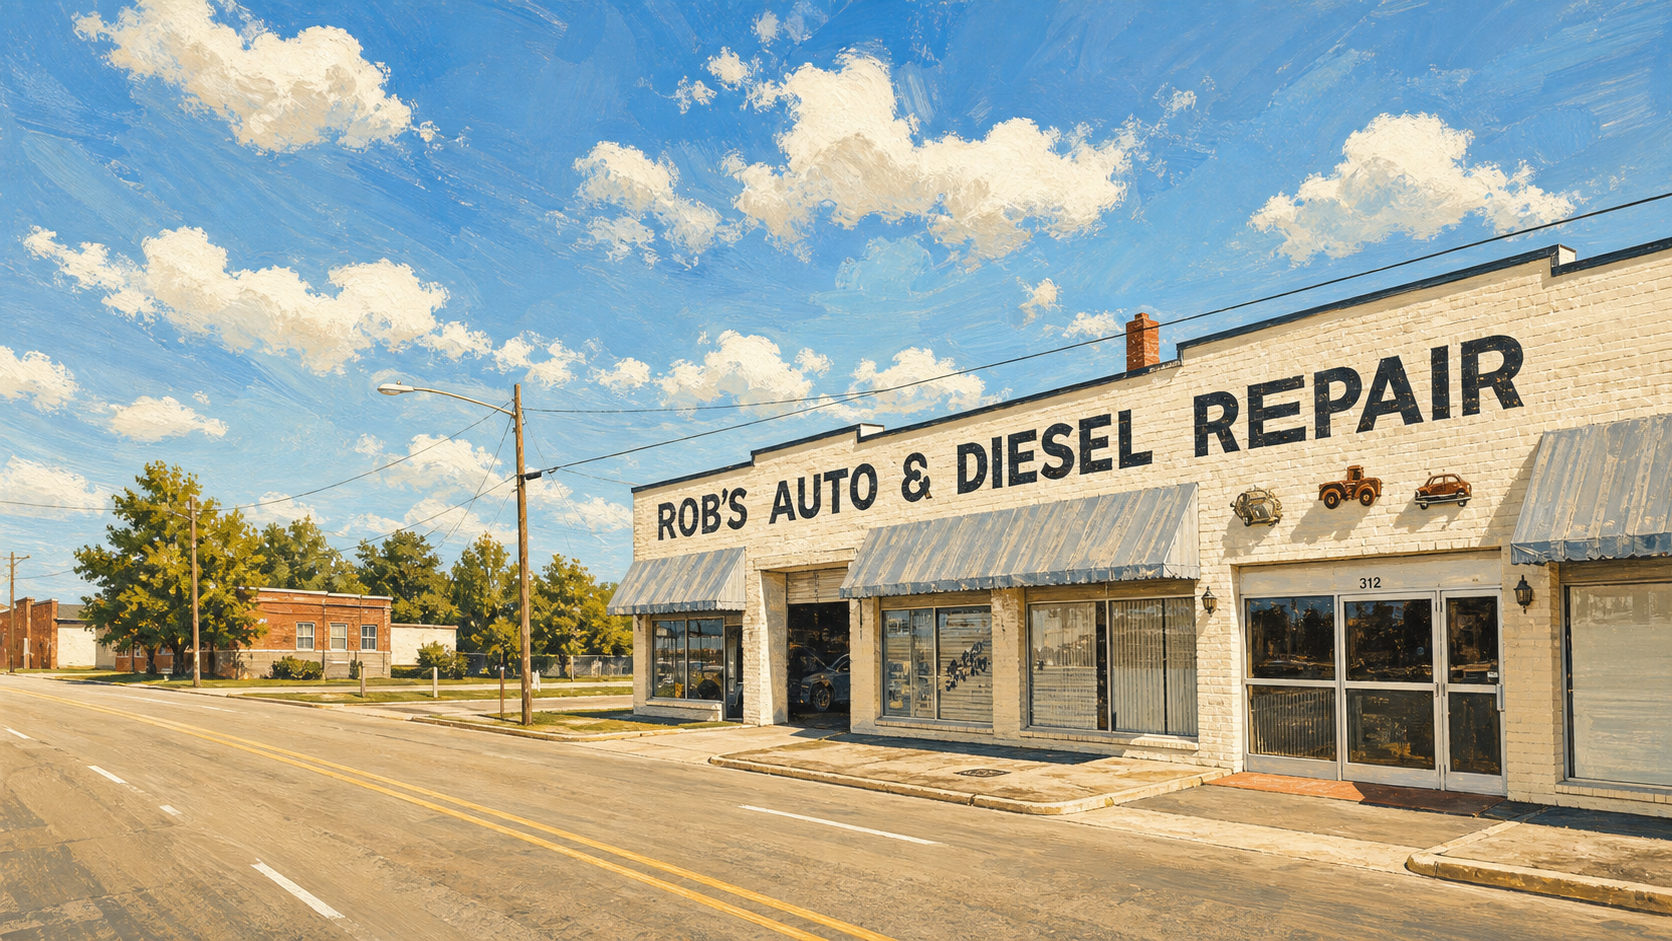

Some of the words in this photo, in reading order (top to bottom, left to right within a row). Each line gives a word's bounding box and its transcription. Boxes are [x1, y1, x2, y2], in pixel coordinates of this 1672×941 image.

[657, 487, 748, 540] ROB'S
[769, 464, 877, 524] AUTO
[901, 453, 932, 502] &
[957, 409, 1152, 494] DIESEL
[1194, 335, 1524, 457] REPAIR
[1359, 577, 1381, 589] 312
